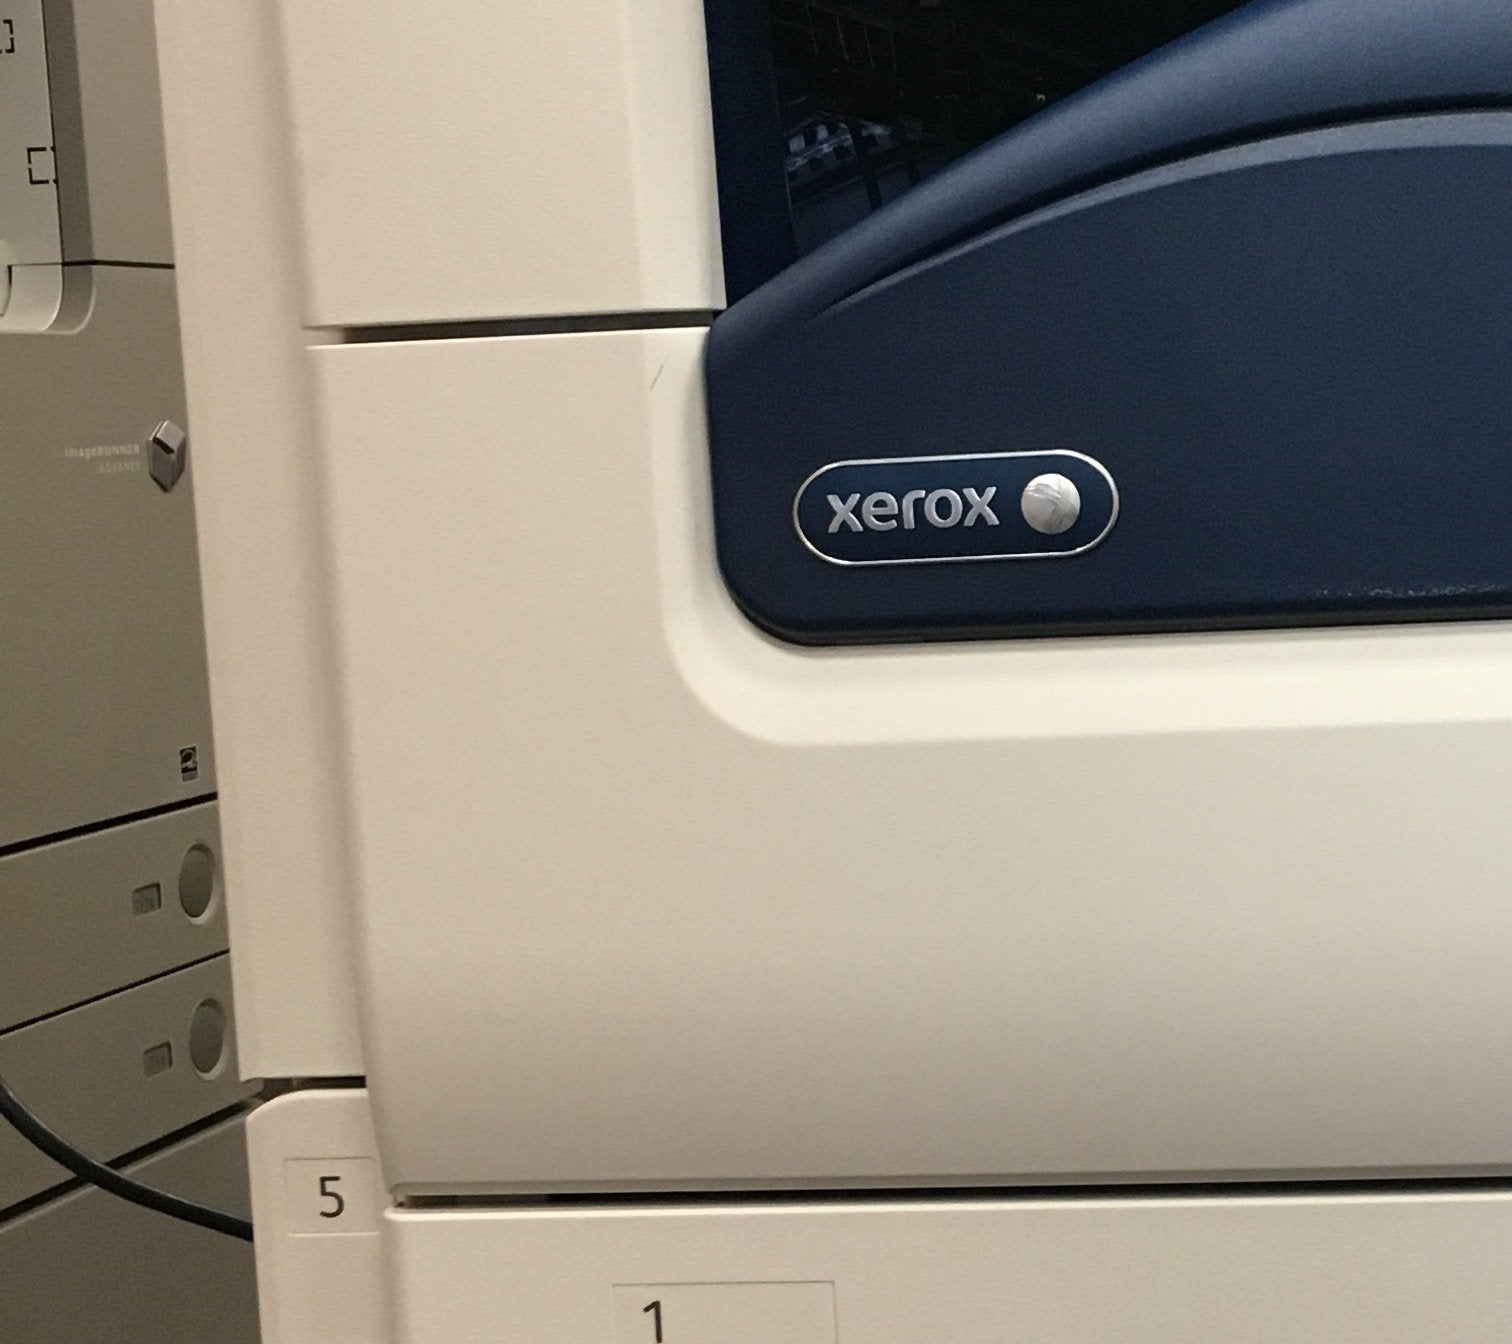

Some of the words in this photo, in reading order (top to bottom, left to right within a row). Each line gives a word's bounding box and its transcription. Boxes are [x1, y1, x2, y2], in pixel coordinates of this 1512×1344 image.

[827, 486, 1000, 534] xerox
[318, 1175, 345, 1219] 5
[642, 1300, 663, 1344] 1
